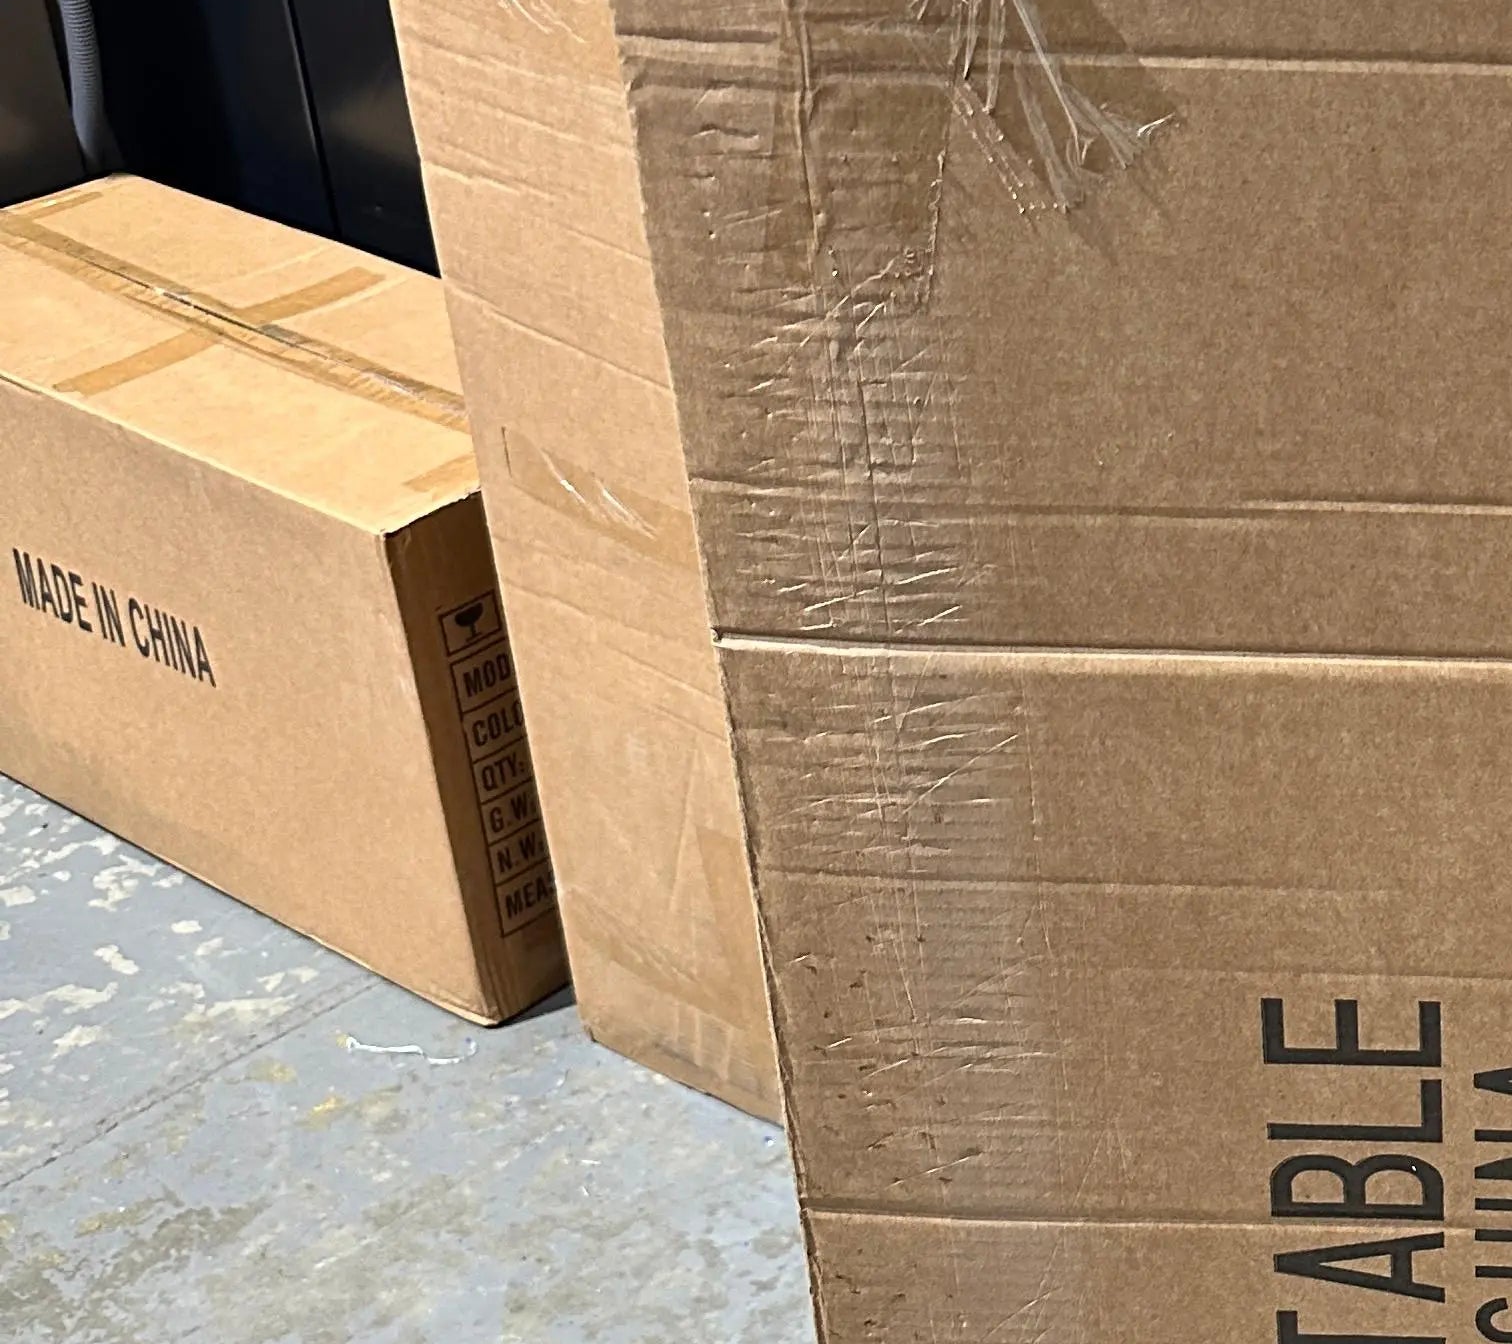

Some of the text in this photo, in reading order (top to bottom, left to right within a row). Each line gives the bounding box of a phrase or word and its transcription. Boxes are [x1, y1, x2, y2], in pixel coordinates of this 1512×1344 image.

[12, 547, 217, 688] MADE IN CHINA
[481, 753, 525, 792] QTY:
